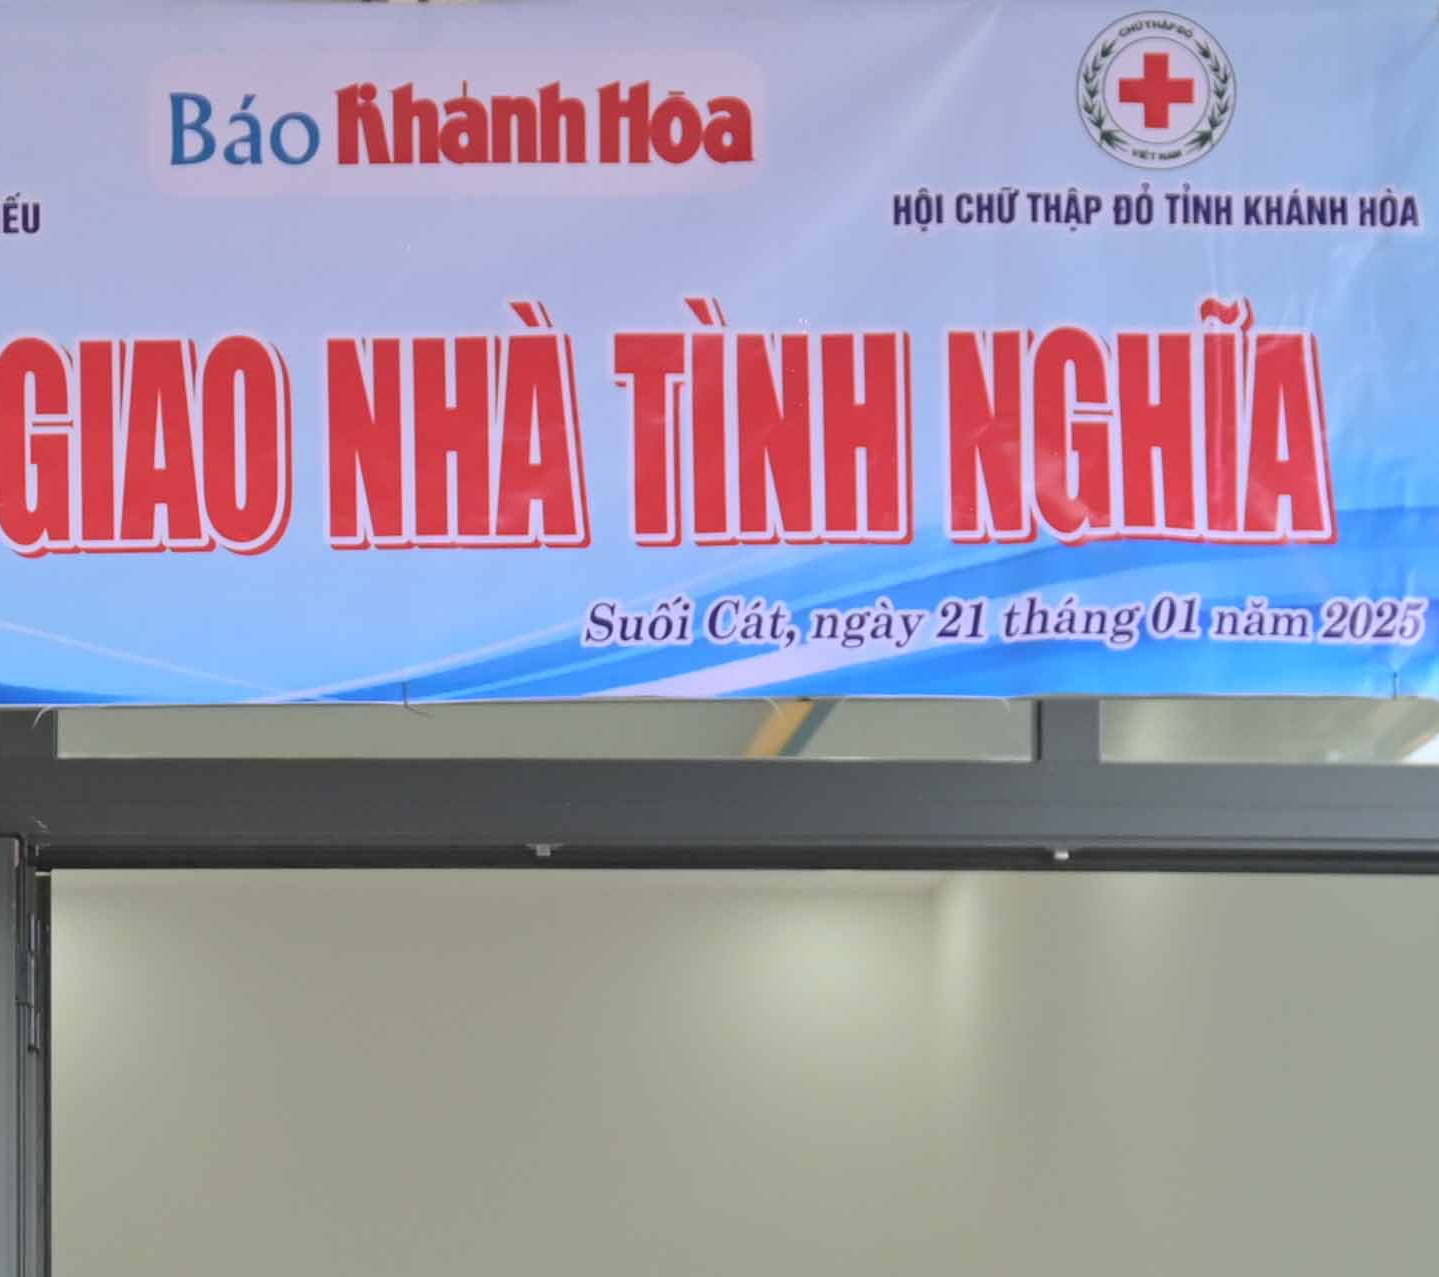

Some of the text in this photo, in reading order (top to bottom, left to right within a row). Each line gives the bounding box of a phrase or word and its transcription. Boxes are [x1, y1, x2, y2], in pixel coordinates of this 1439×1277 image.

[169, 93, 320, 166] Báo
[893, 183, 1419, 232] HỘI CHỮ THẬP ĐỎ TỈNH KHÁNH HÒA
[327, 298, 590, 551] NHÀ
[614, 296, 912, 546] TÌNH
[947, 296, 1337, 546] NGHĨA
[583, 594, 1426, 651] Suối Cát, ngày 21 tháng 01 năm 2025
